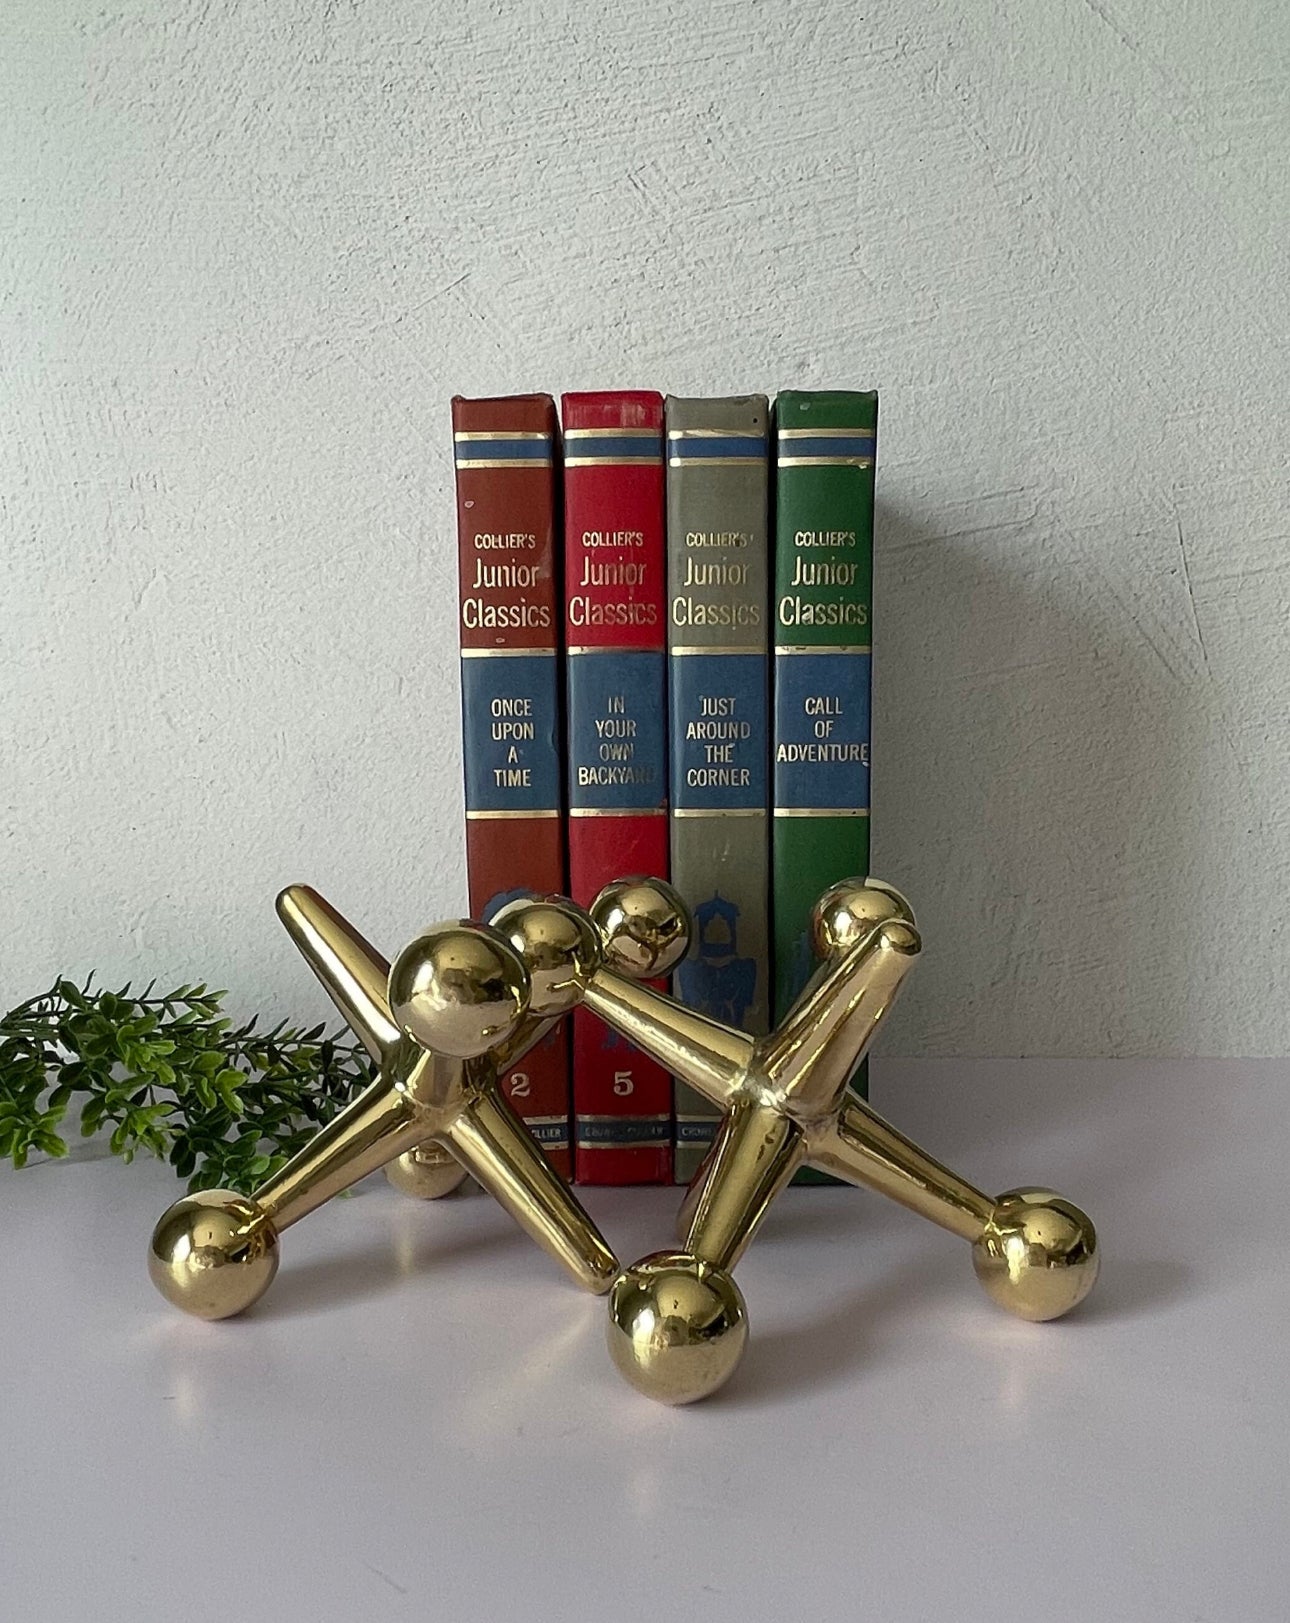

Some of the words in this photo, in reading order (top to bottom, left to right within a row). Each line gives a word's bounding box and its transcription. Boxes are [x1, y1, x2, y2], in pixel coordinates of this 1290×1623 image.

[474, 531, 536, 550] COLLIER'S
[582, 531, 643, 548] COLLIER'S
[686, 532, 748, 548] COLLIER'S
[794, 531, 856, 548] COLLIER'S
[472, 558, 540, 589] Junior
[579, 556, 647, 587] Junior
[683, 556, 751, 587] Junior
[791, 556, 858, 586] Junior
[463, 597, 551, 629] Classics
[569, 596, 657, 626] Classics
[672, 596, 760, 626] Classics
[779, 596, 867, 626] Classics
[491, 698, 533, 717] ONCE
[607, 696, 625, 714] IN
[700, 697, 737, 716] JUST
[804, 697, 843, 716] CALL
[491, 722, 535, 741] UPON
[594, 719, 638, 738] YOUR
[686, 721, 751, 740] AROUND
[814, 720, 834, 739] OF
[507, 745, 519, 764] A
[599, 743, 635, 762] OWN
[704, 744, 734, 763] THE
[776, 743, 869, 762] ADVENTURE
[493, 769, 532, 787] TIME
[686, 768, 750, 787] CORNER
[510, 1072, 531, 1097] 2
[613, 1070, 634, 1096] 5
